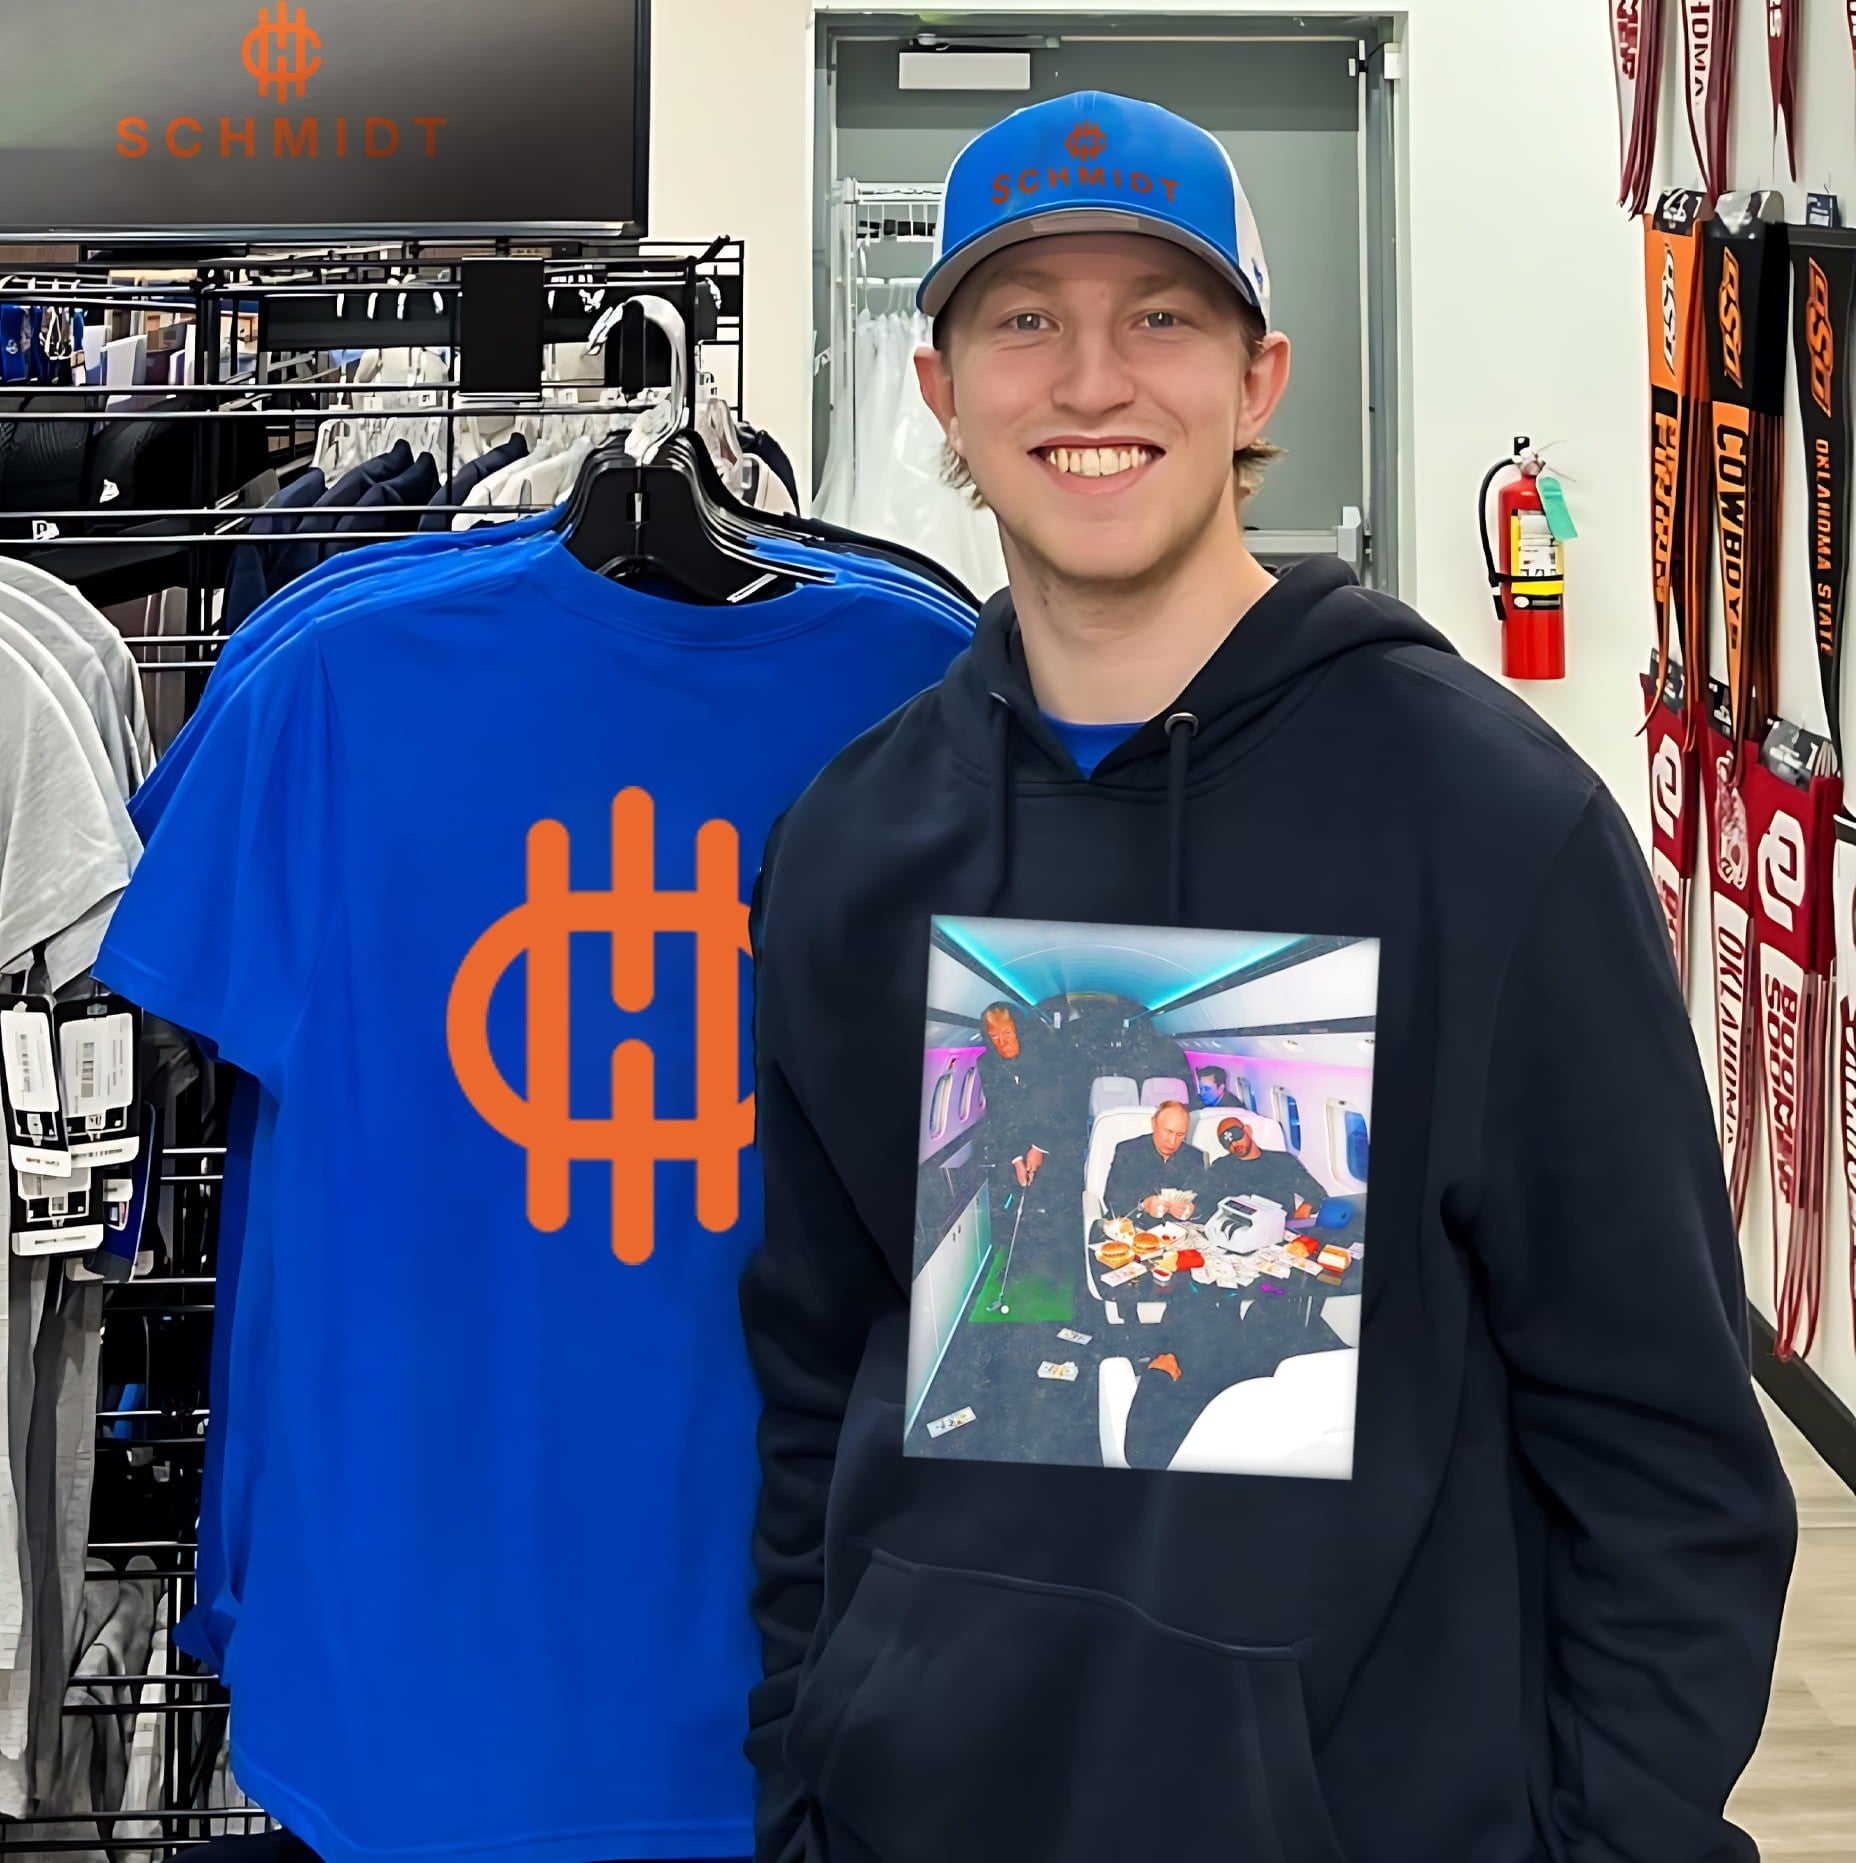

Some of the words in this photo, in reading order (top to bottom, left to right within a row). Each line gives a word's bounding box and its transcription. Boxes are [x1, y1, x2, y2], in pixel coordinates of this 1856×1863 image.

[116, 116, 447, 158] SCHMIDT
[991, 167, 1179, 204] SCHMIDT
[1815, 438, 1832, 571] OKLAHOMA
[1717, 925, 1745, 1144] OKLAHOMA
